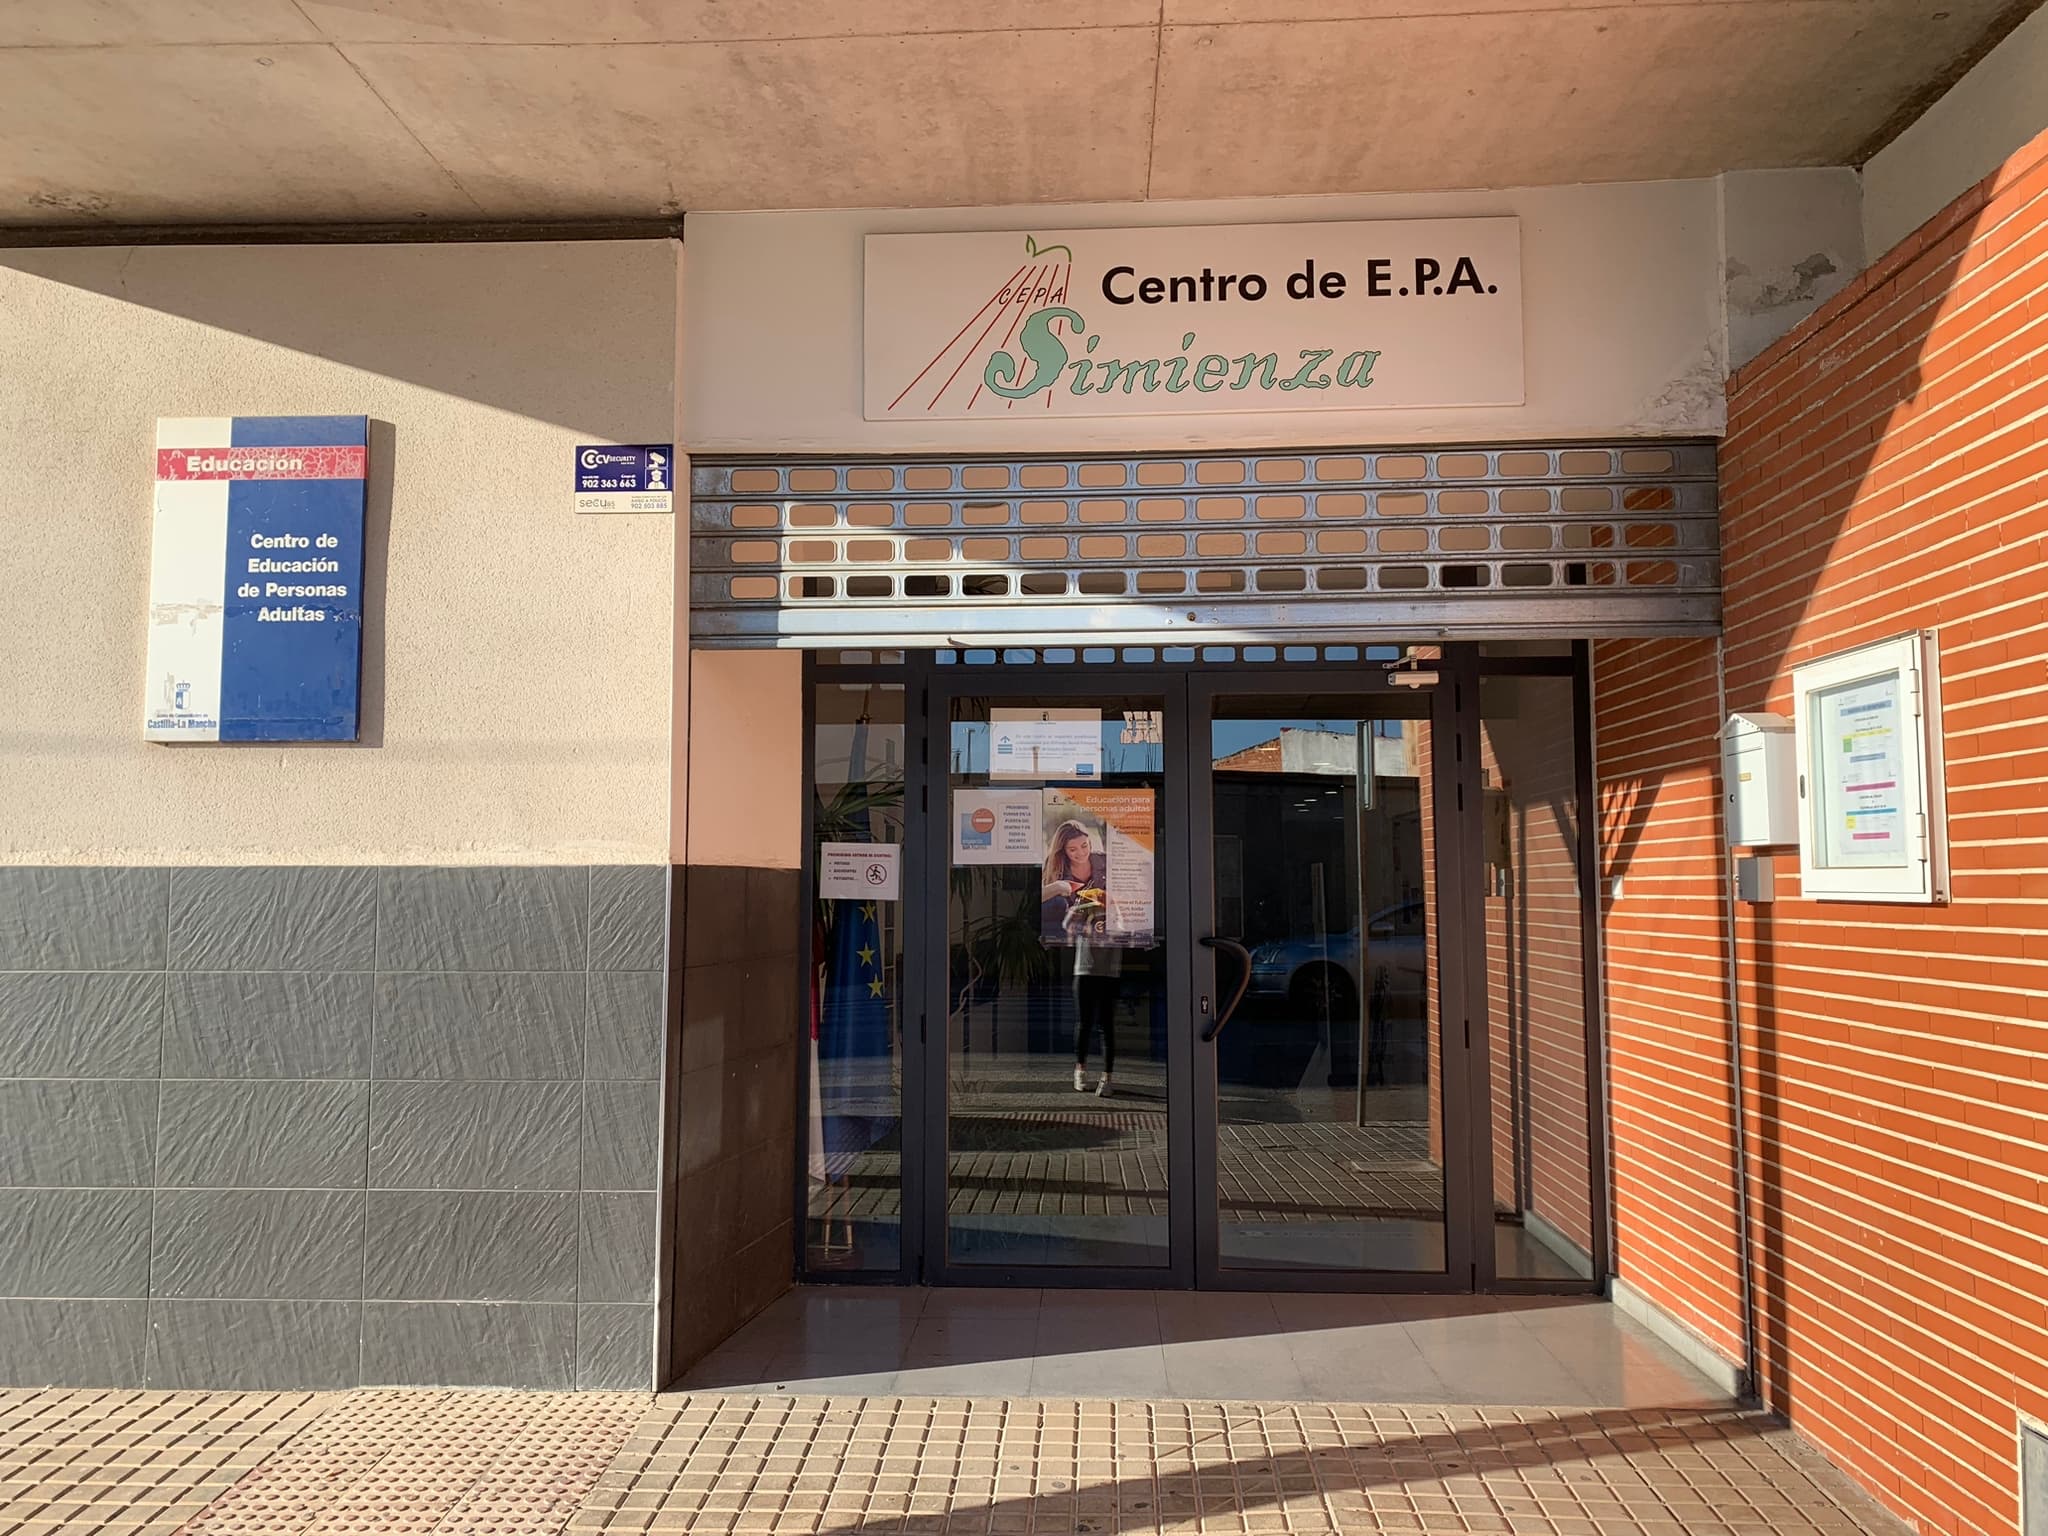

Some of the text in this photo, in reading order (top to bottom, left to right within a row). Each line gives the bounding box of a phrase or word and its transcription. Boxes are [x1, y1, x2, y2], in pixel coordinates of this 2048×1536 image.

[1101, 256, 1498, 305] Centro de E.P.A.
[984, 307, 1381, 399] Simienza
[186, 454, 303, 473] Educación
[582, 478, 636, 488] 902 363 663
[250, 533, 338, 549] Centro de
[248, 556, 339, 573] Educación
[237, 582, 348, 598] de Personas
[257, 607, 325, 622] Adultas
[147, 718, 217, 730] Castilla-La Mancha
